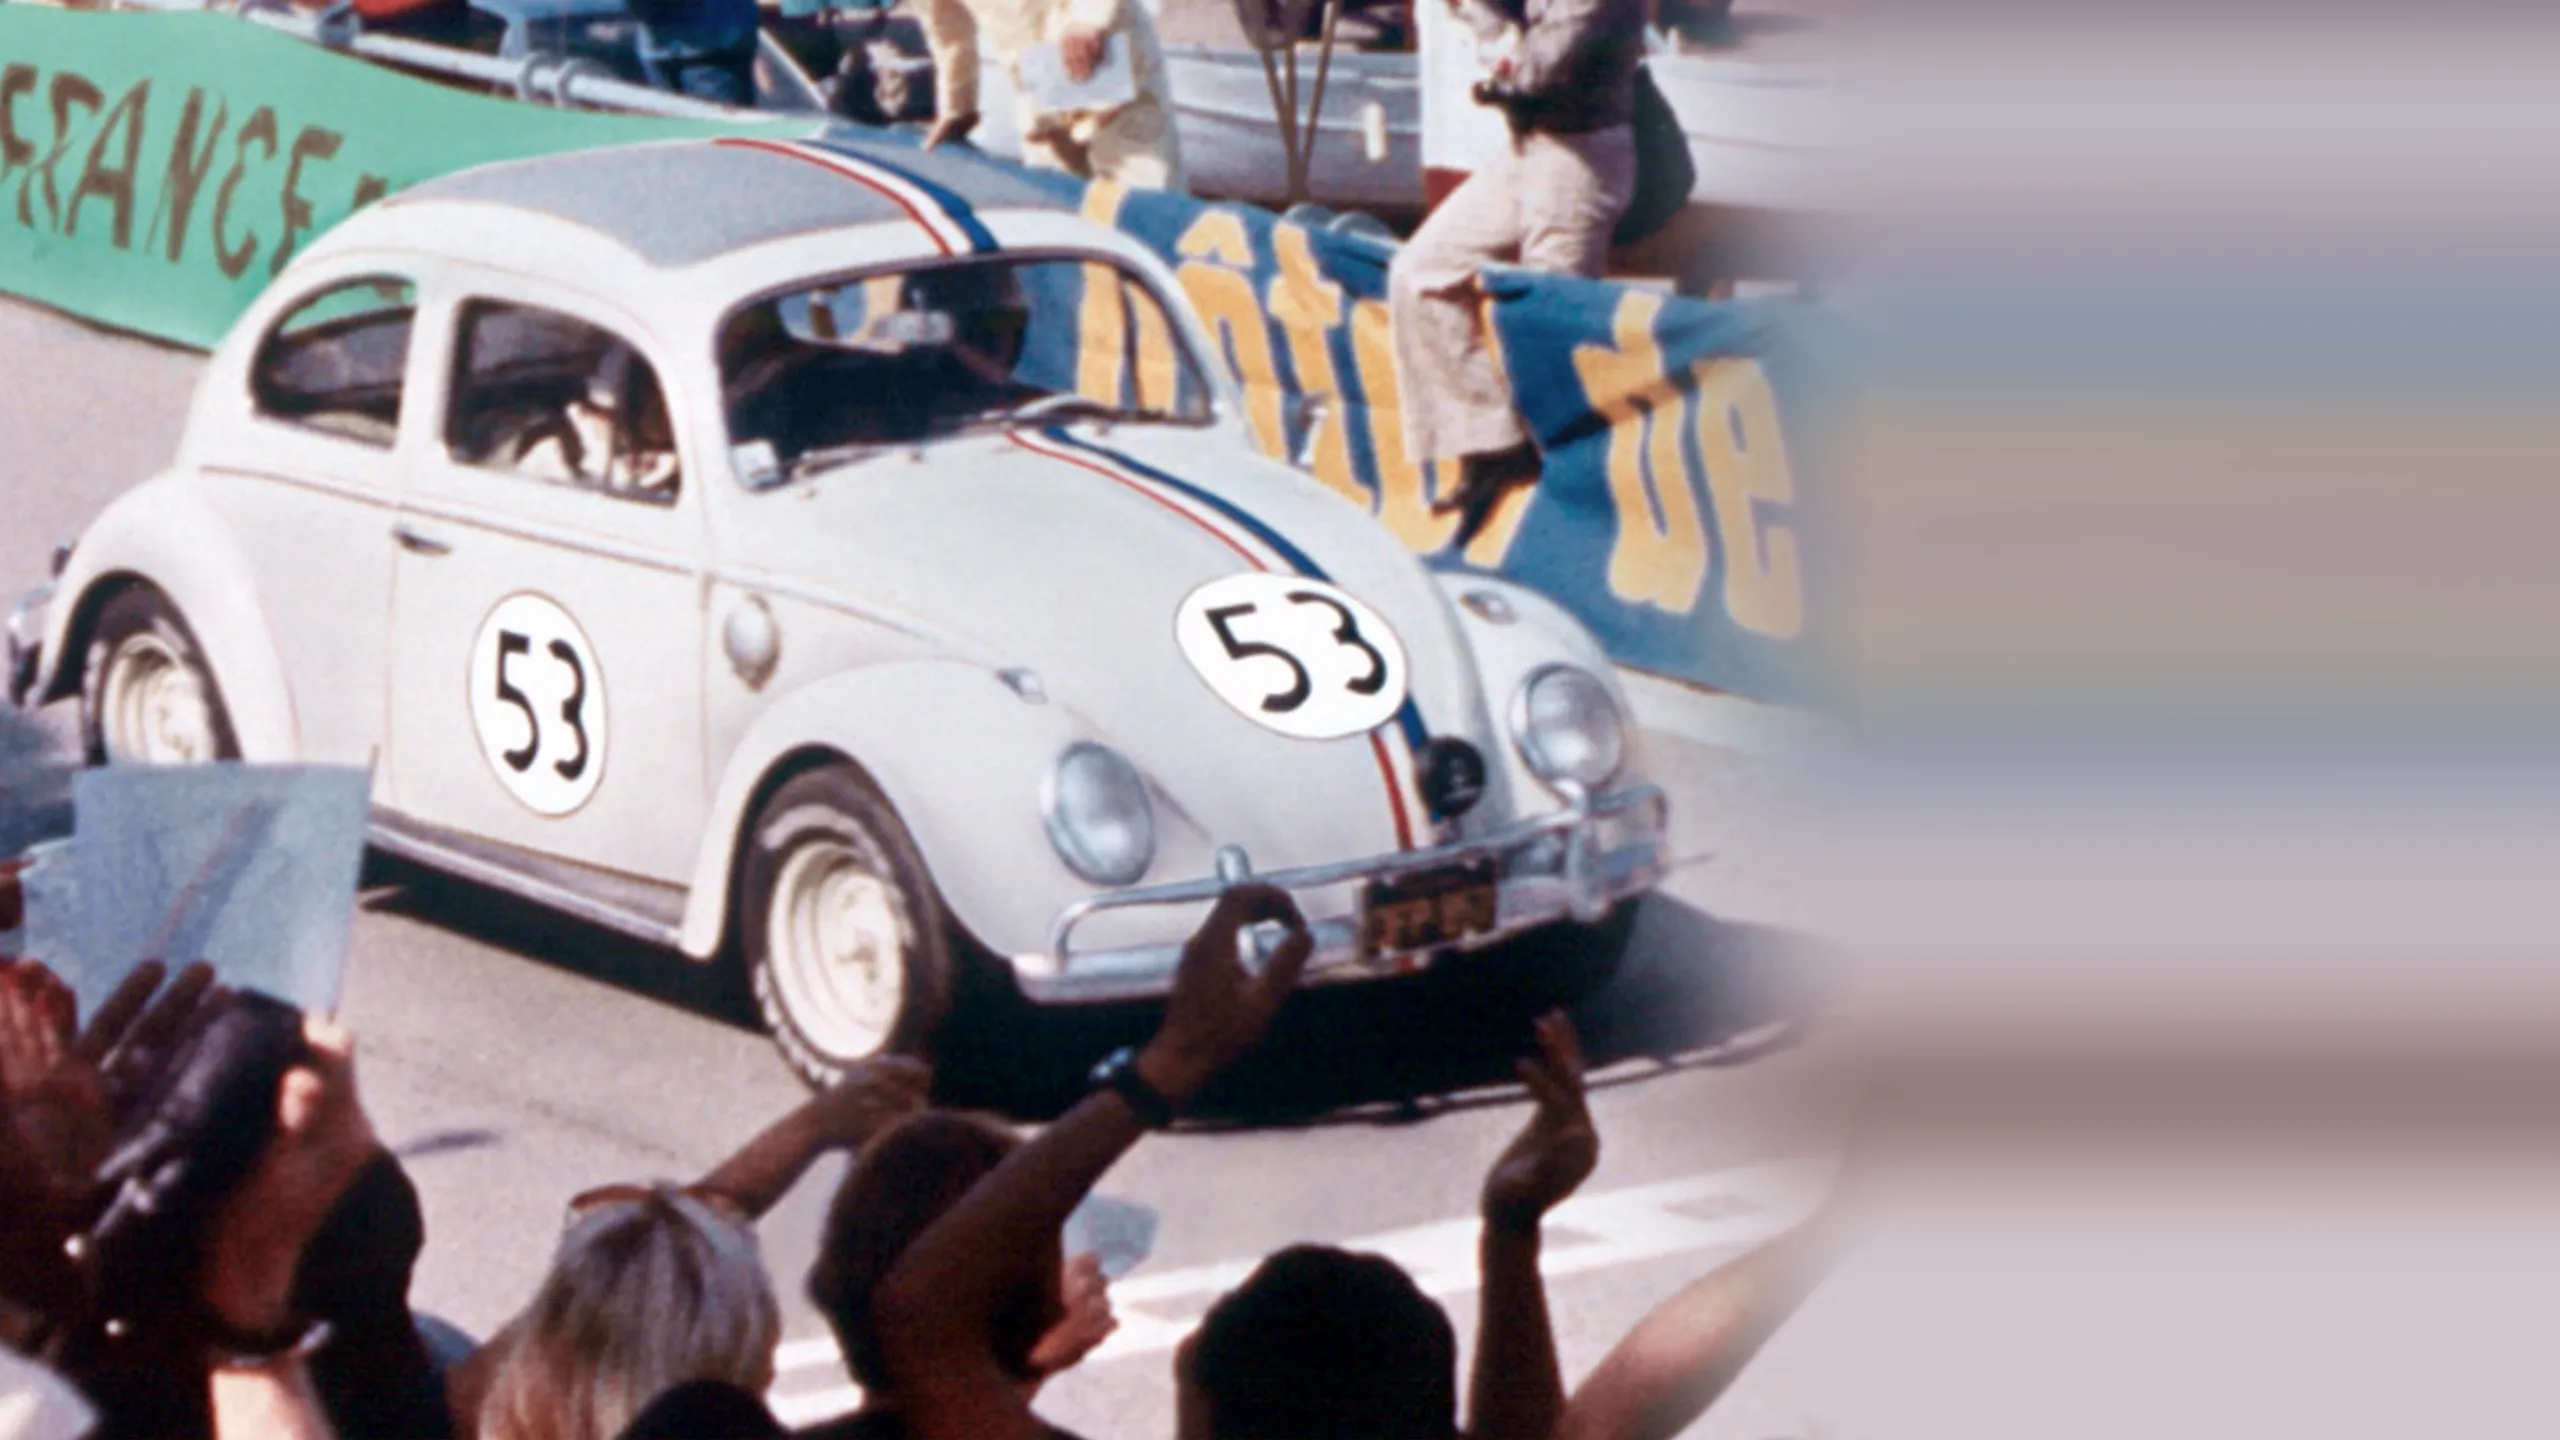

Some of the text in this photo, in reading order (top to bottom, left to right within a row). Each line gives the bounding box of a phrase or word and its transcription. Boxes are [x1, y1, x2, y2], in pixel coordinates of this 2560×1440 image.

[1572, 289, 1803, 641] de
[496, 628, 588, 781] 53
[1205, 590, 1387, 713] 53
